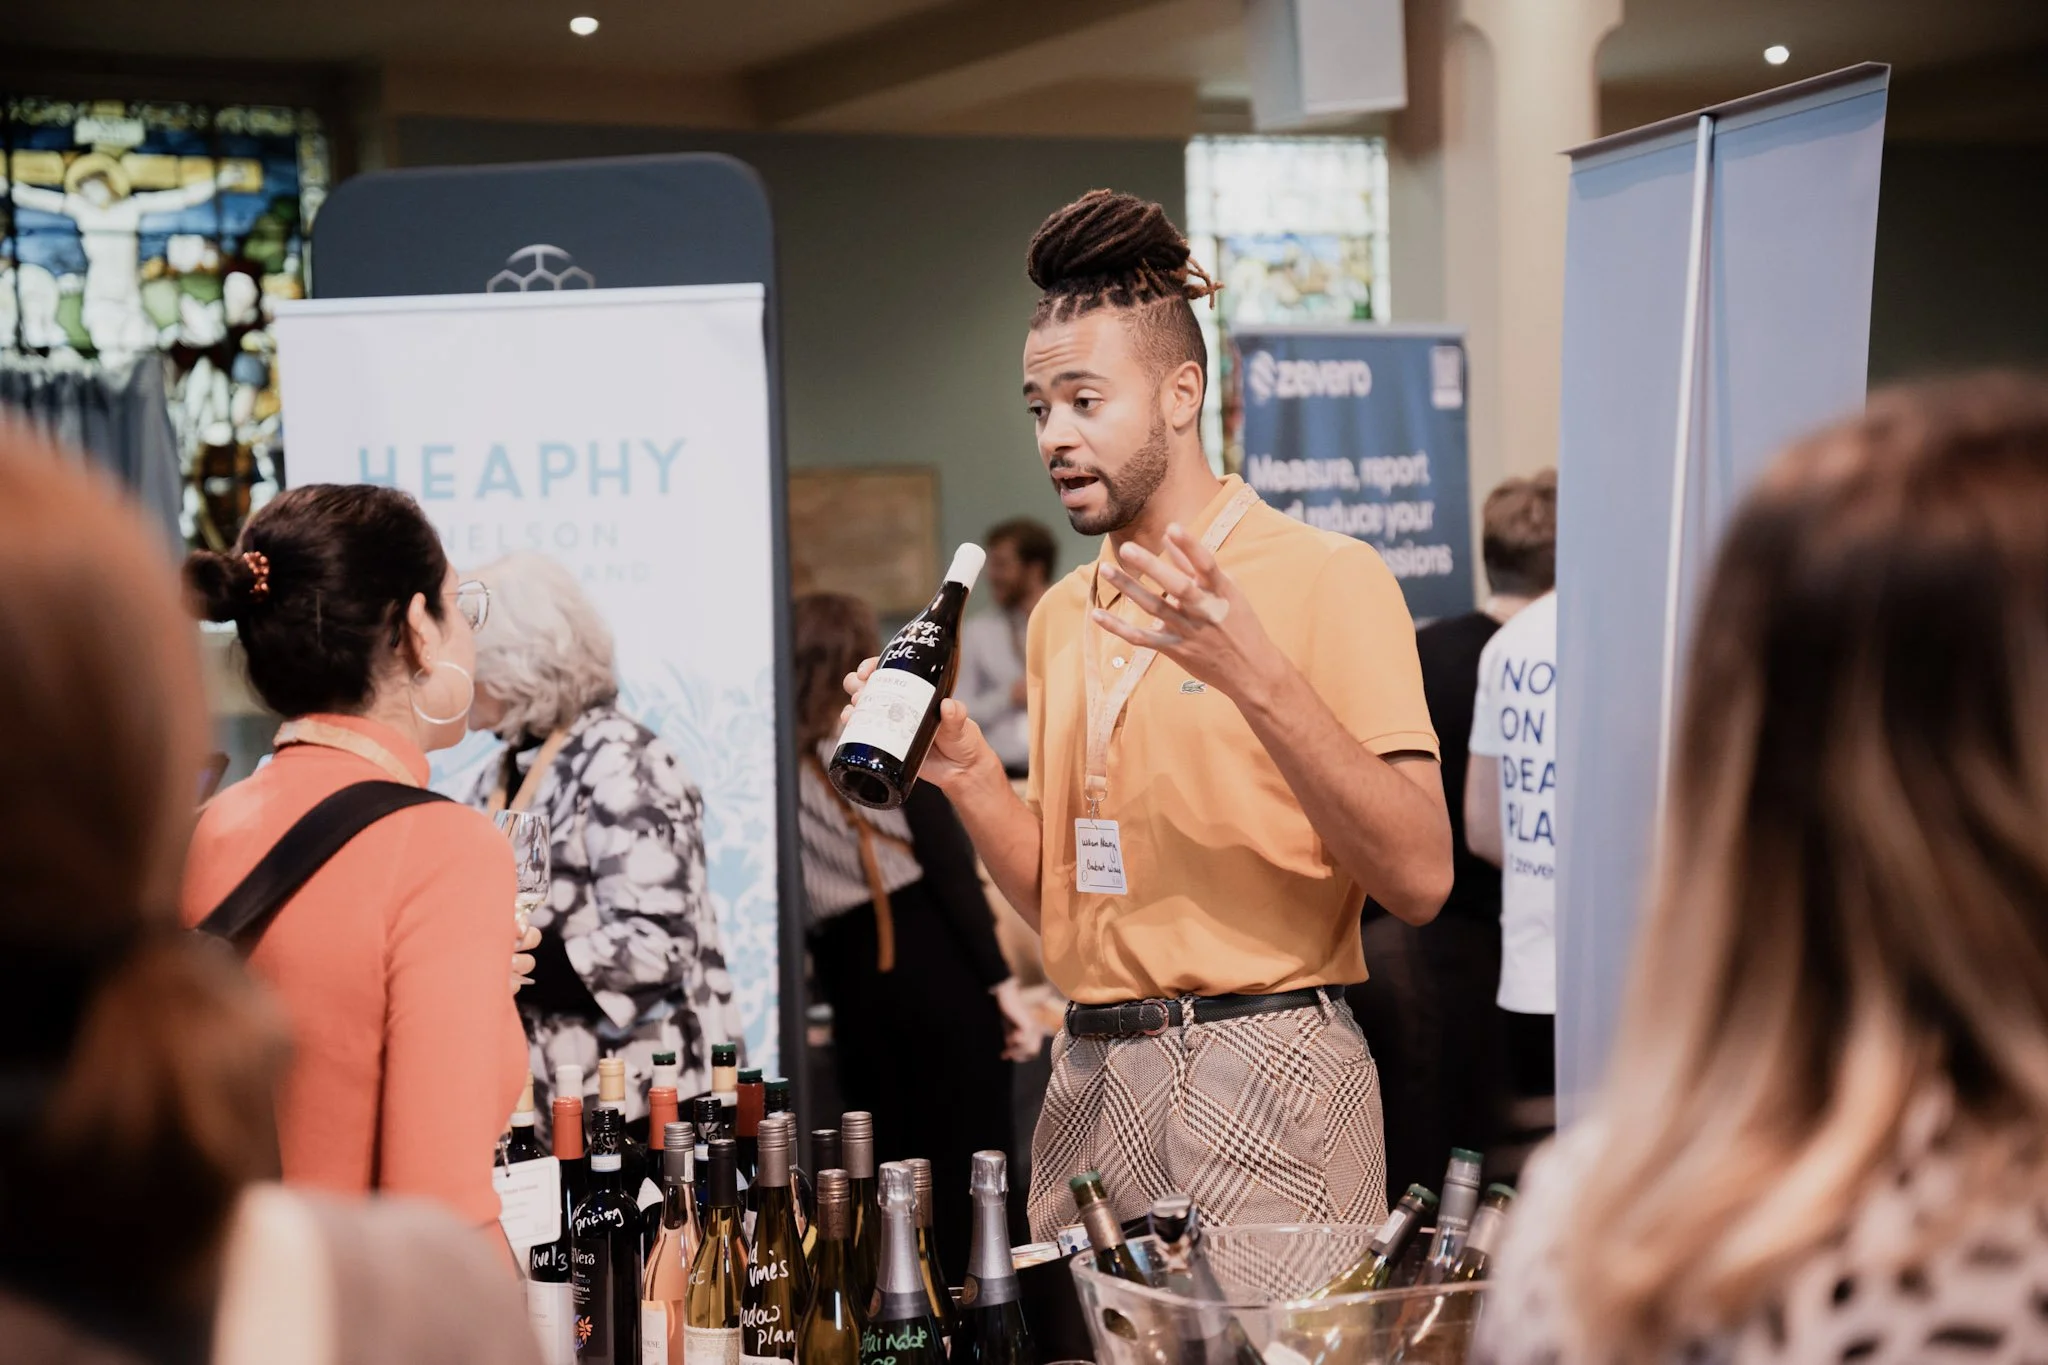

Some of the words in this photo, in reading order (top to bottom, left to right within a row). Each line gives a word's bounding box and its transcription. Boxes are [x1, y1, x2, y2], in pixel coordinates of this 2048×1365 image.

[1274, 359, 1372, 397] zevero
[358, 439, 687, 499] HEAPHY
[1502, 706, 1544, 744] ON
[1503, 755, 1556, 793] DEA
[1508, 803, 1555, 846] PLA
